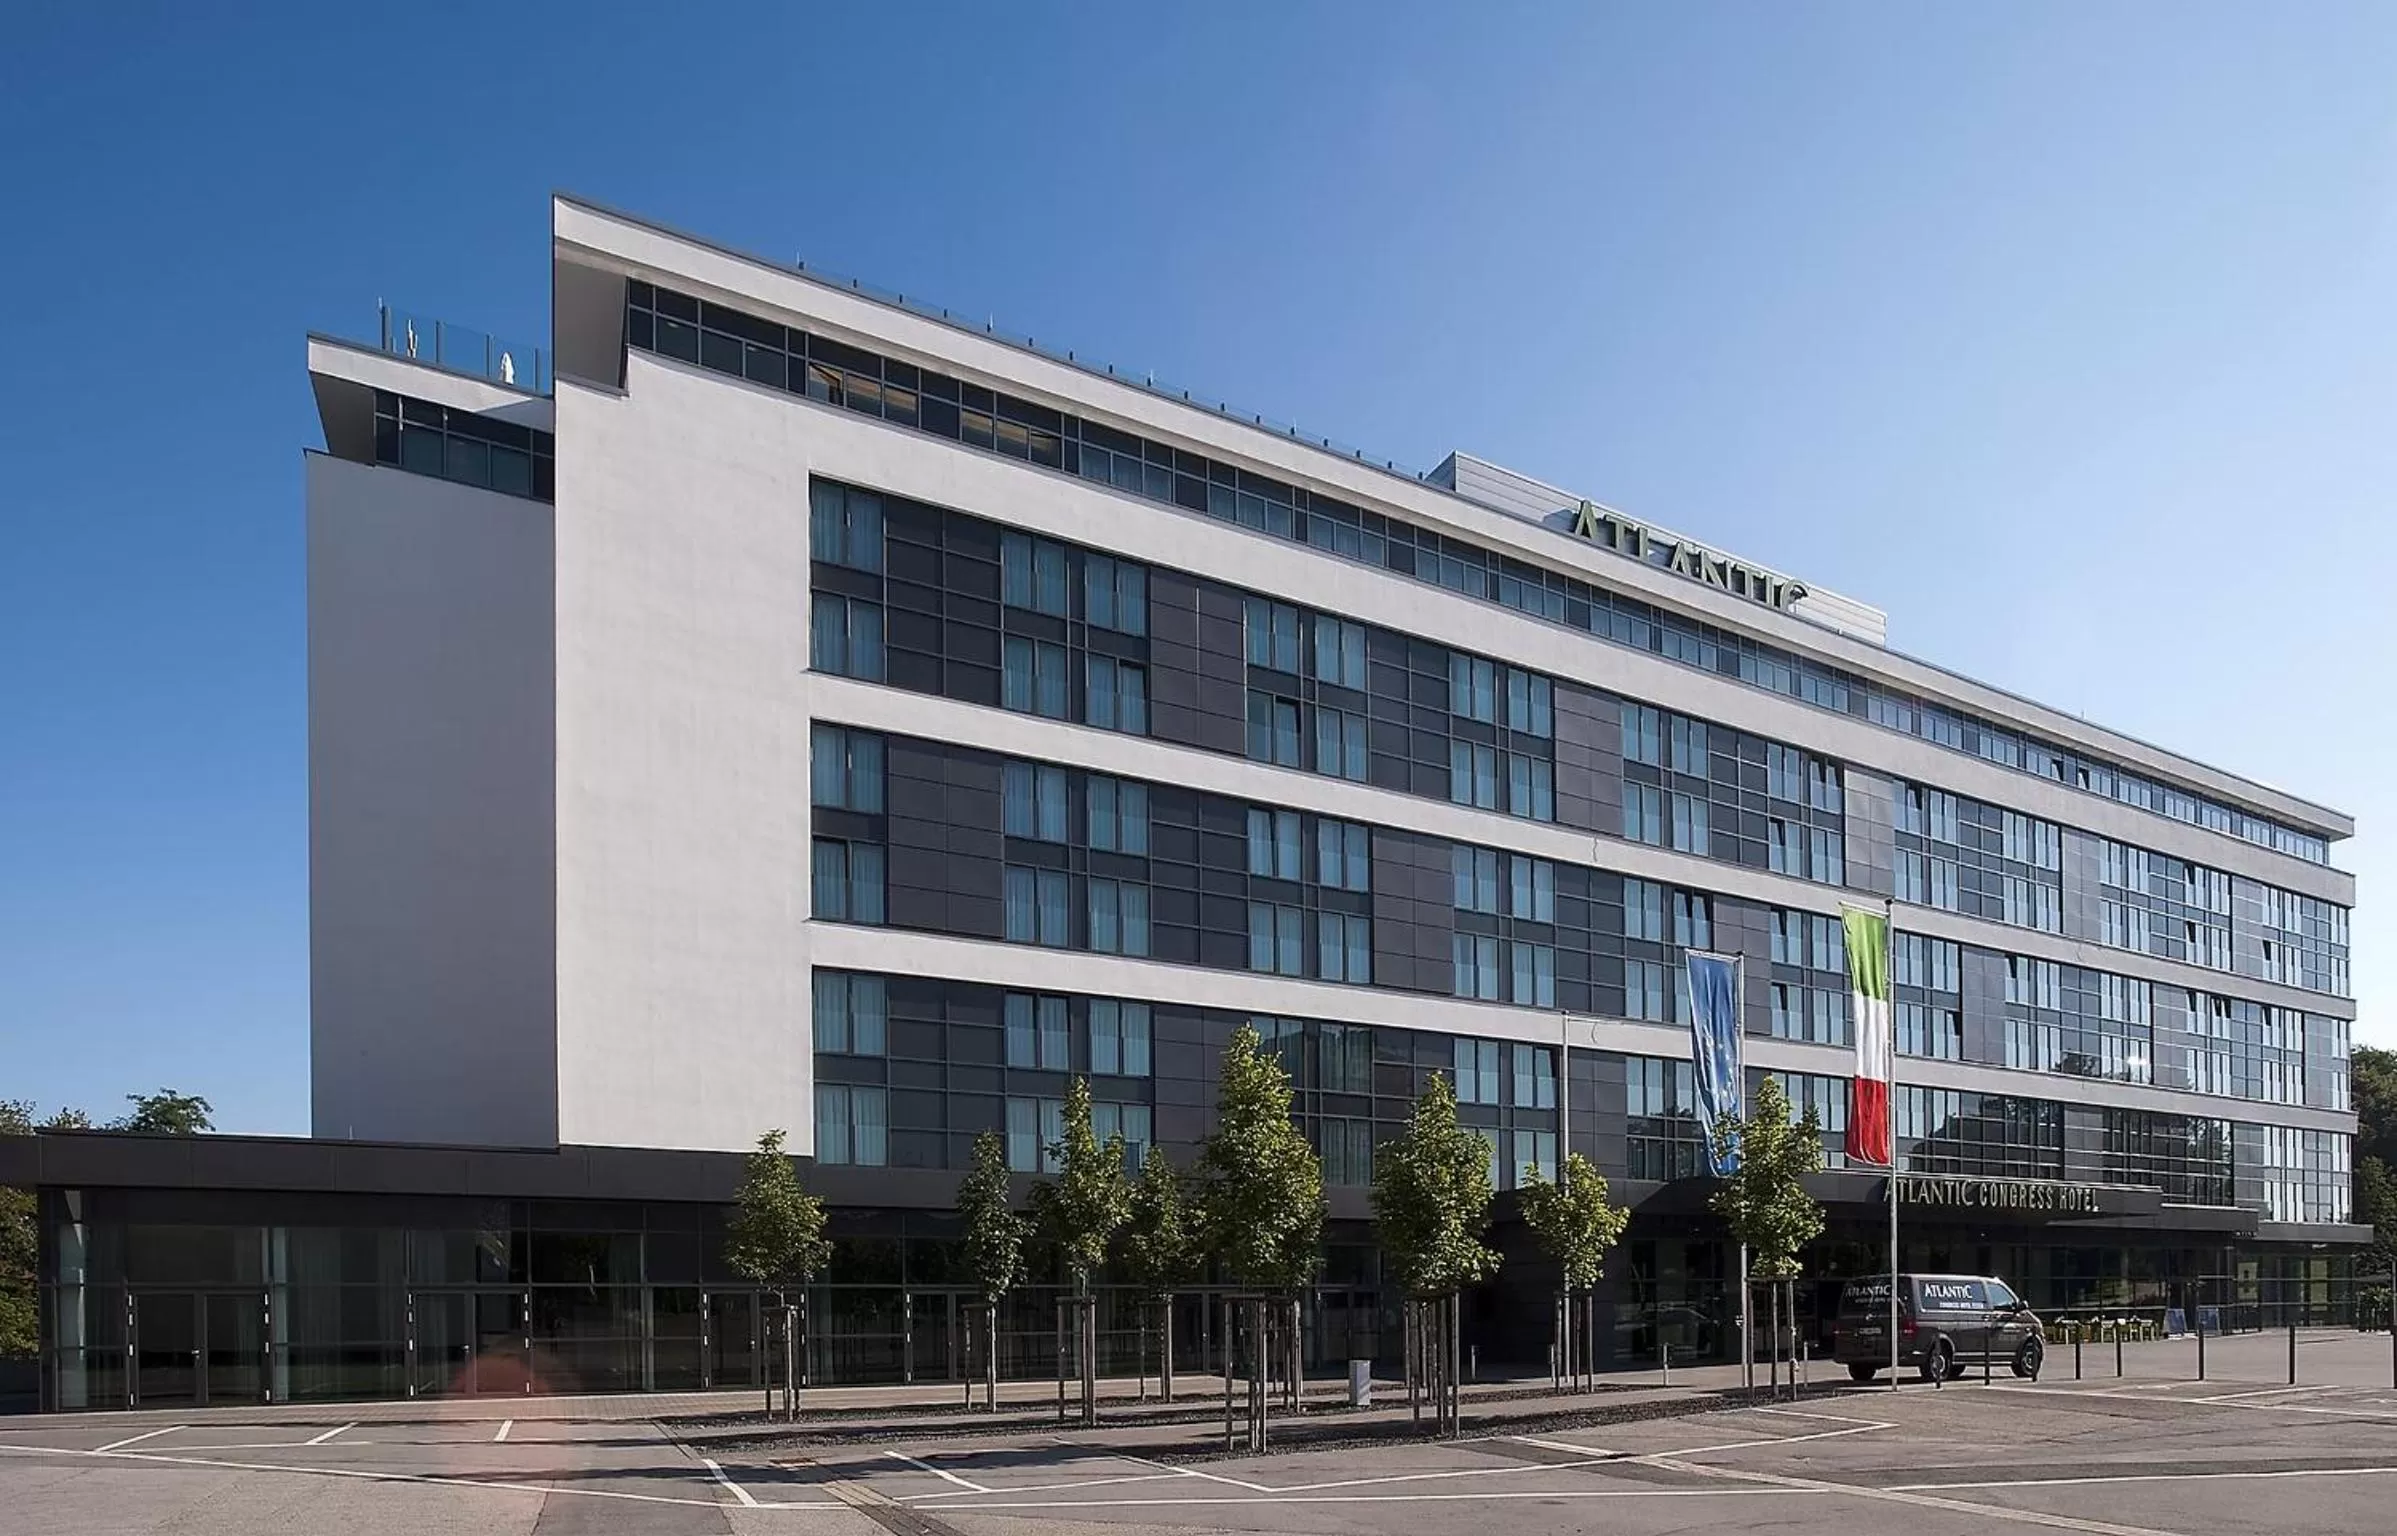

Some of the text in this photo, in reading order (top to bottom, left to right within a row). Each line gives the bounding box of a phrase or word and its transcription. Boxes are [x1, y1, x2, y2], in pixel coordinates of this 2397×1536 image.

[1574, 500, 1810, 612] ATLANTIC
[1979, 1182, 2054, 1209] CONGRESS
[2059, 1187, 2100, 1212] HOTEL
[1925, 1284, 1972, 1298] ATLANTIC
